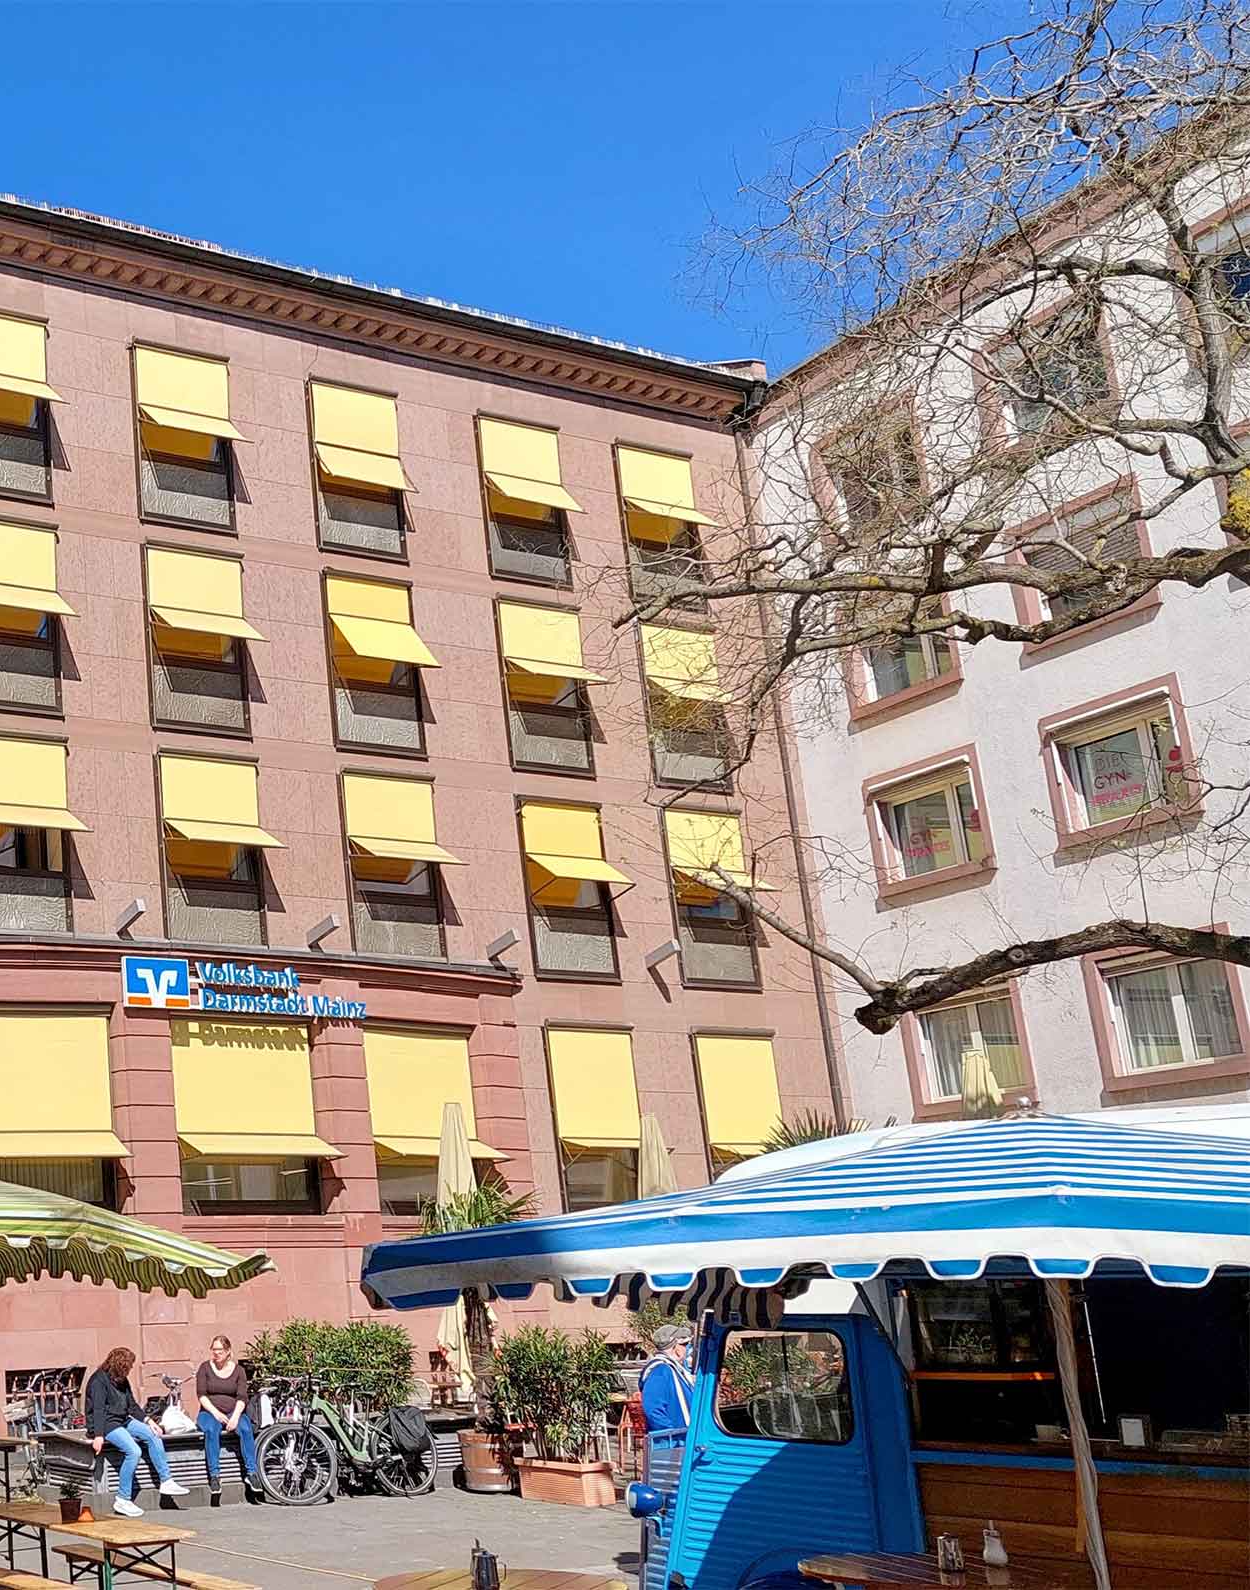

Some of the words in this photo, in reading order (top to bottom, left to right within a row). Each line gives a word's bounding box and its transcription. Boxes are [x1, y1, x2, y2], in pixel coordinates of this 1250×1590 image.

[195, 961, 300, 989] Volksbank
[199, 988, 308, 1014] Darmstadt
[310, 995, 366, 1019] Mainz
